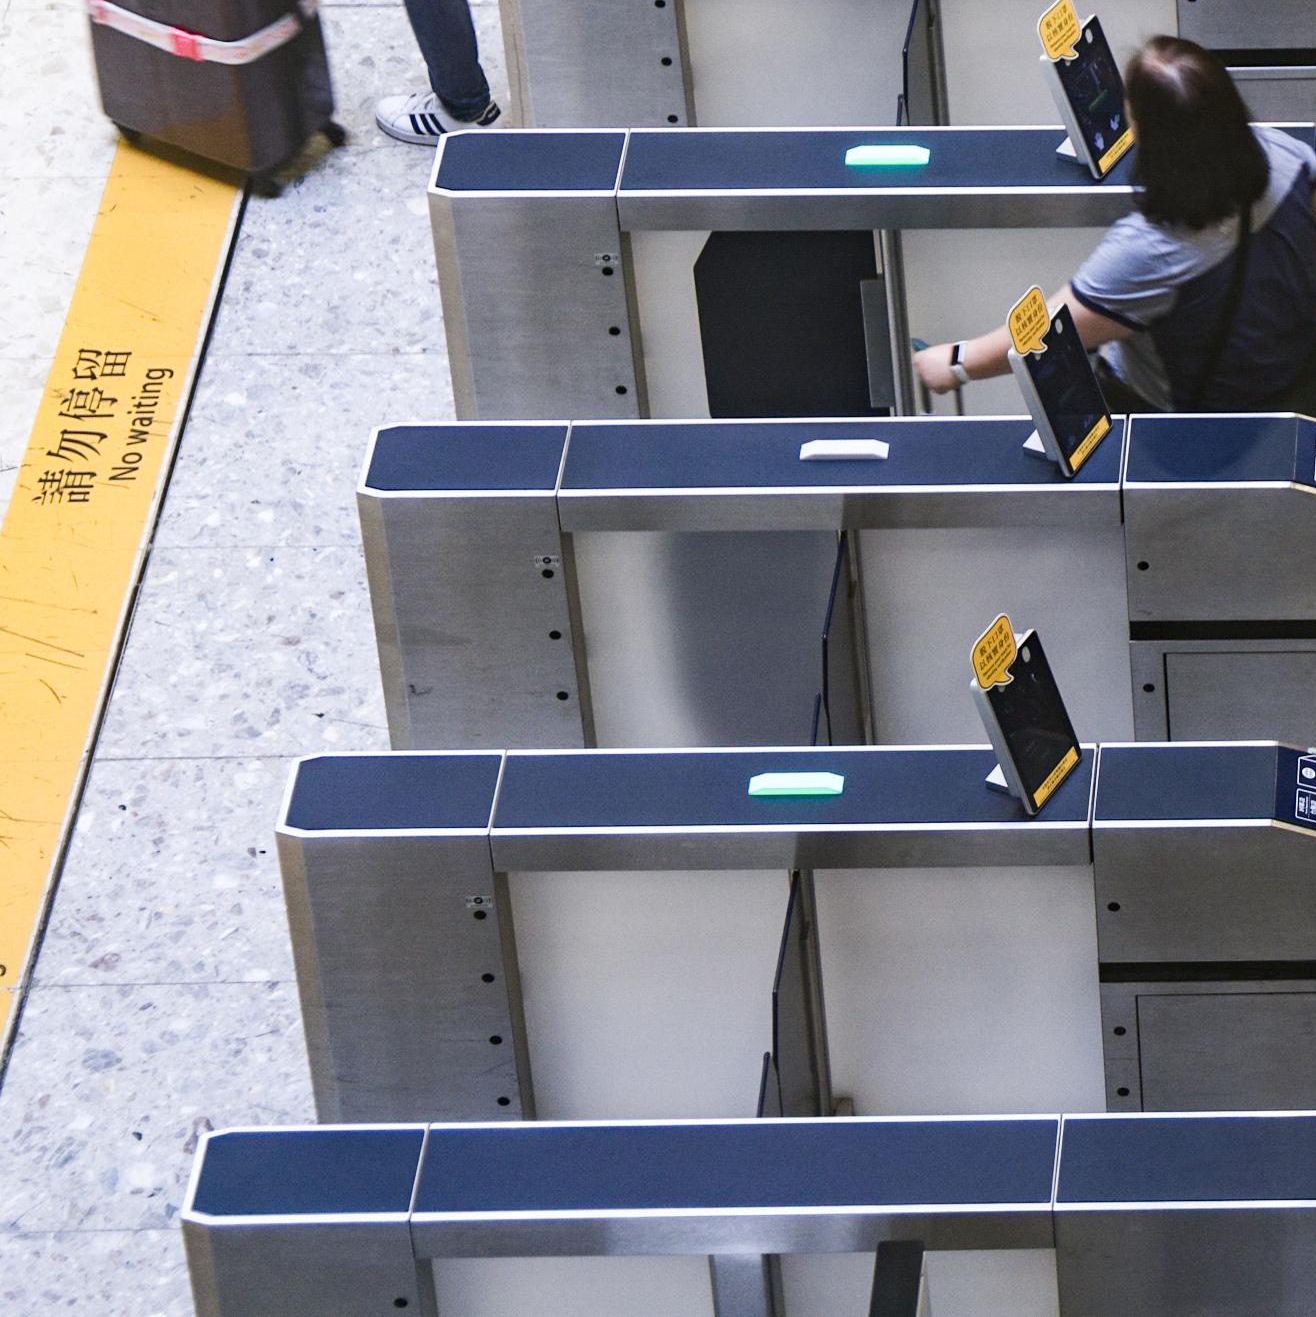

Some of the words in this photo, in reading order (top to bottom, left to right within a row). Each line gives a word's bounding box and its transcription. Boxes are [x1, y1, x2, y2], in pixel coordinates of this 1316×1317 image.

[31, 348, 132, 506] 請勿停留
[108, 452, 144, 481] No
[126, 368, 174, 446] waiting
